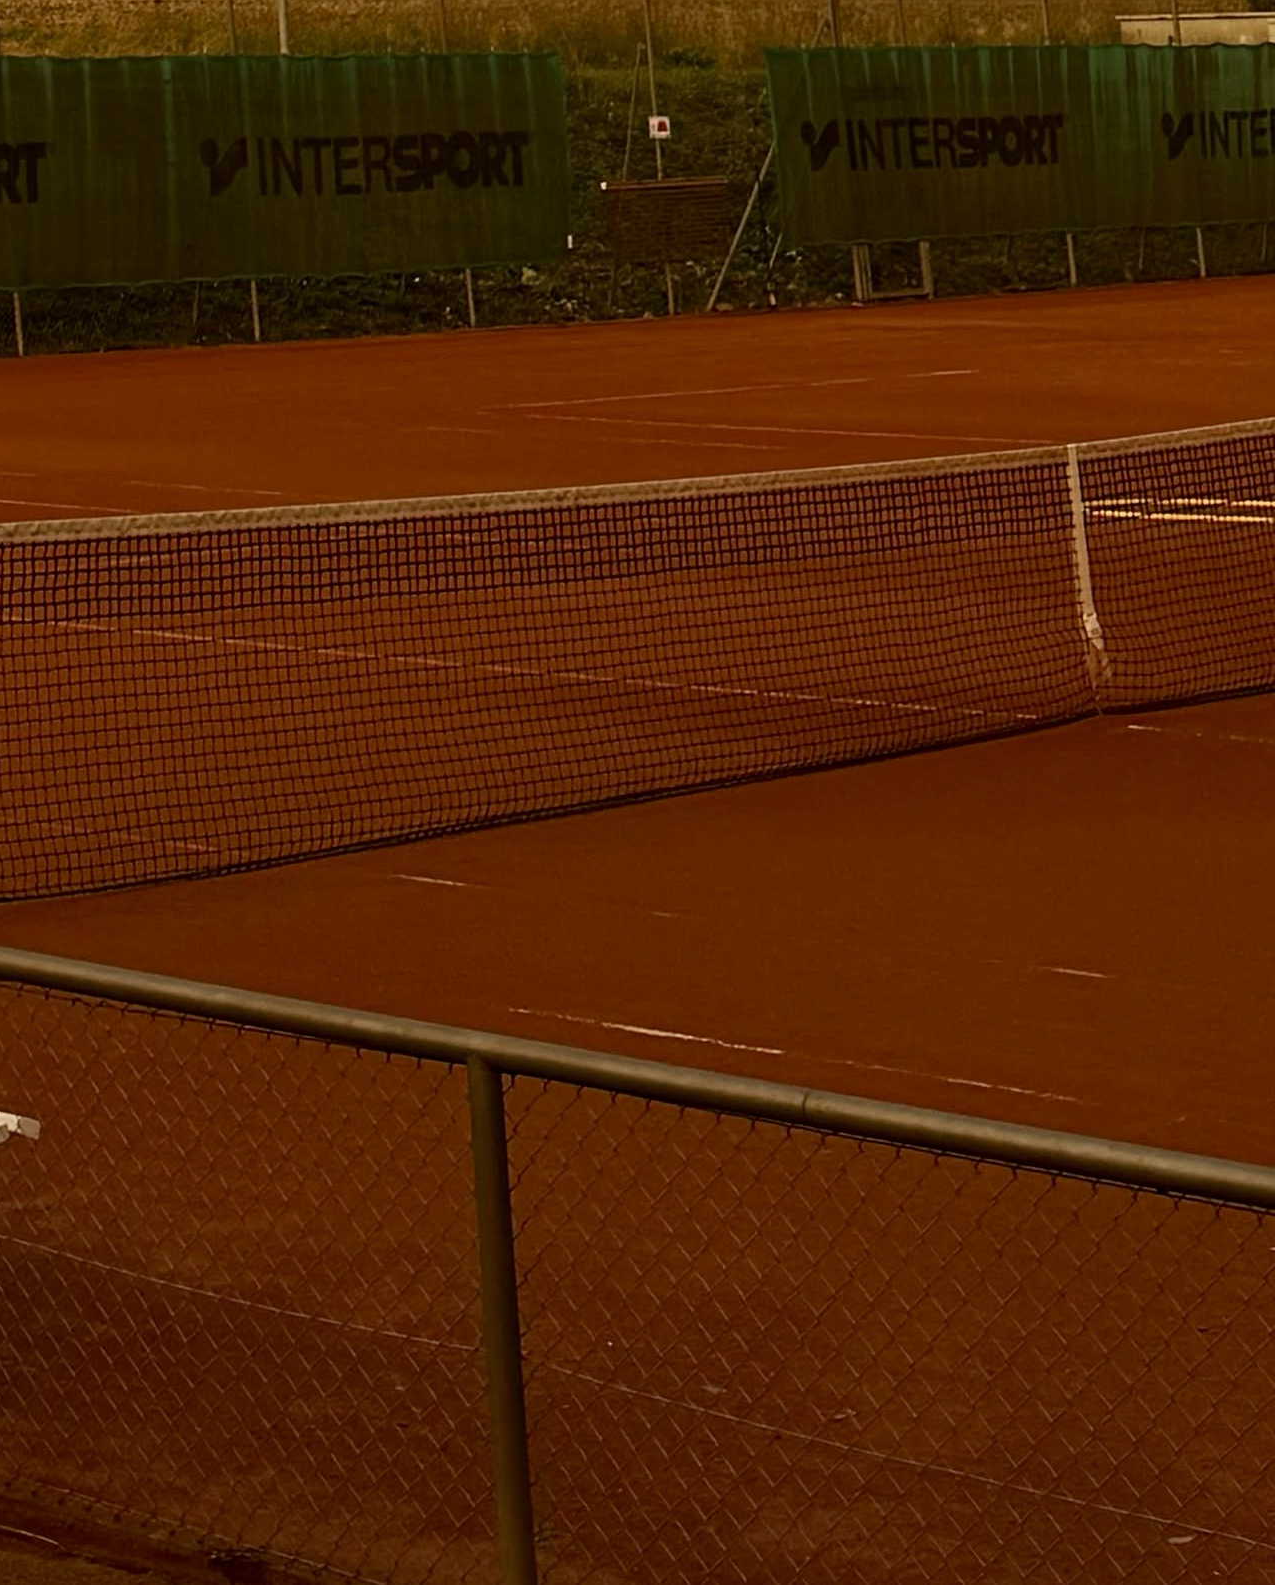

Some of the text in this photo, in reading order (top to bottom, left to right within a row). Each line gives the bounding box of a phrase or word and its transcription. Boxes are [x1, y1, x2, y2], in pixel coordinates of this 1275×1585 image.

[846, 113, 1064, 171] INTERSPORT
[1199, 107, 1275, 159] INTE
[256, 130, 529, 197] INTERSPORT
